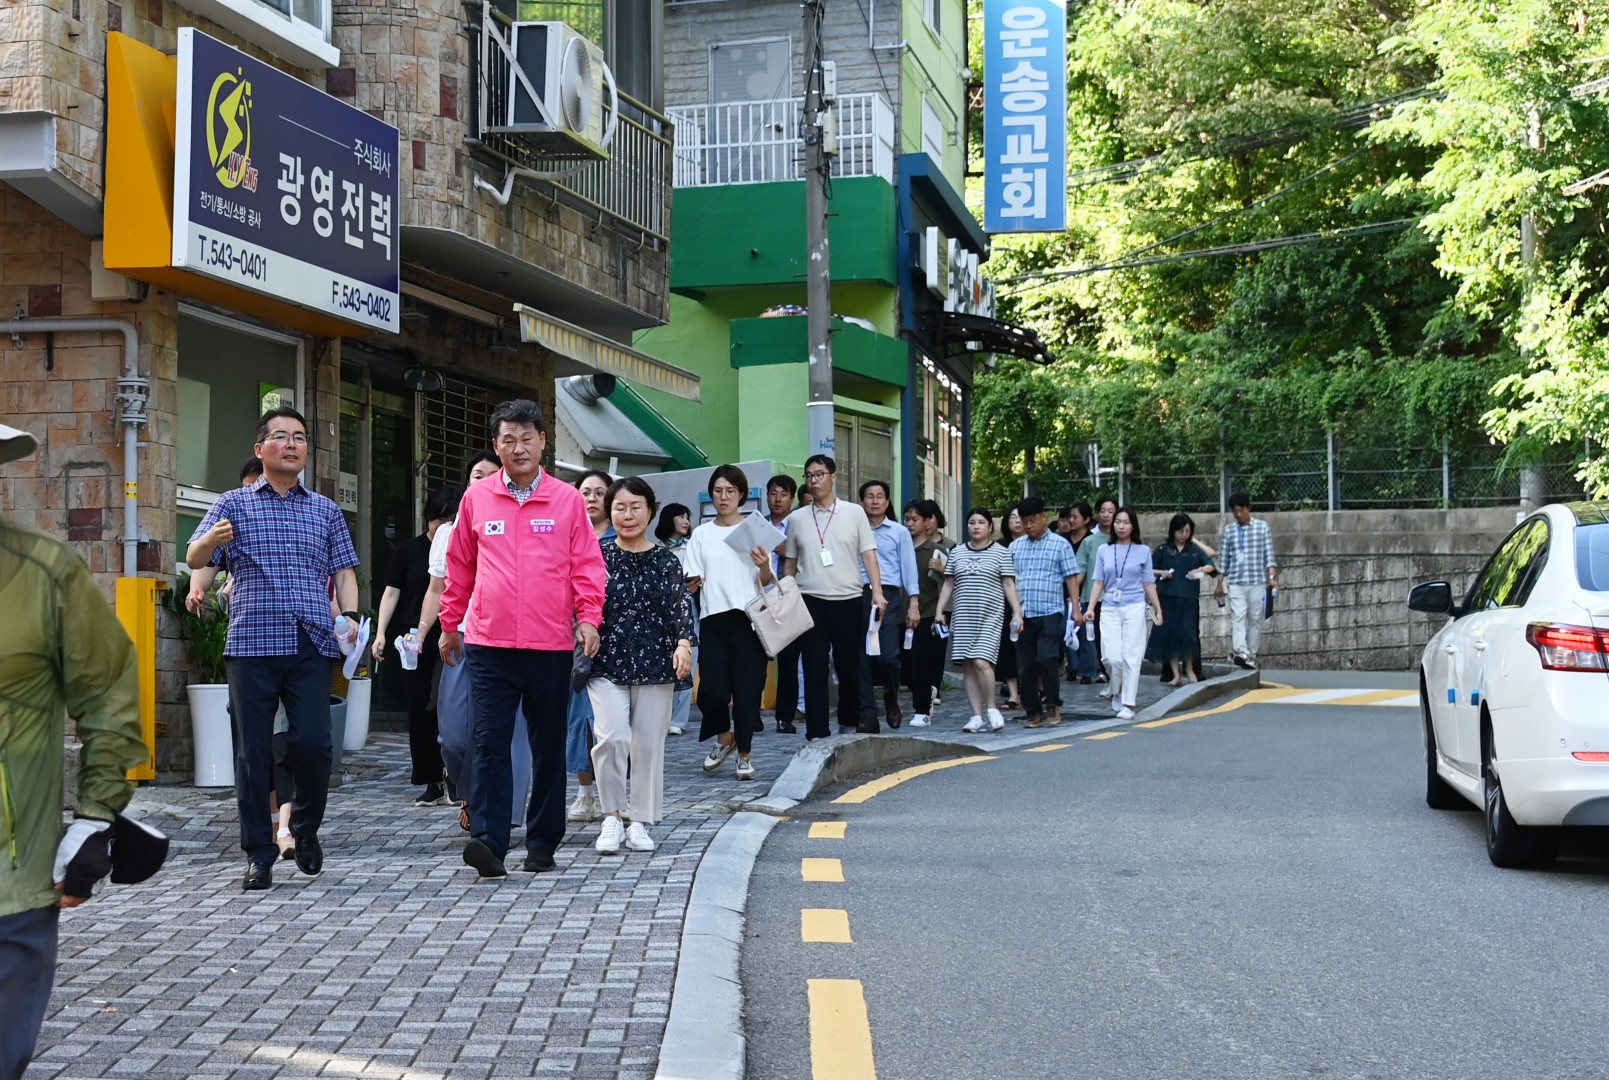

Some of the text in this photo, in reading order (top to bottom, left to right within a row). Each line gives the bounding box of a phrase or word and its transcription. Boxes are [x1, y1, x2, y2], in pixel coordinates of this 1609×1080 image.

[1000, 6, 1049, 219] 운송교회
[354, 138, 391, 179] 주식회사
[200, 191, 261, 229] 전기/통신/소방 공사
[277, 152, 391, 261] 광영전력
[198, 234, 267, 282] T.543-0401
[332, 280, 391, 322] F.543-0402
